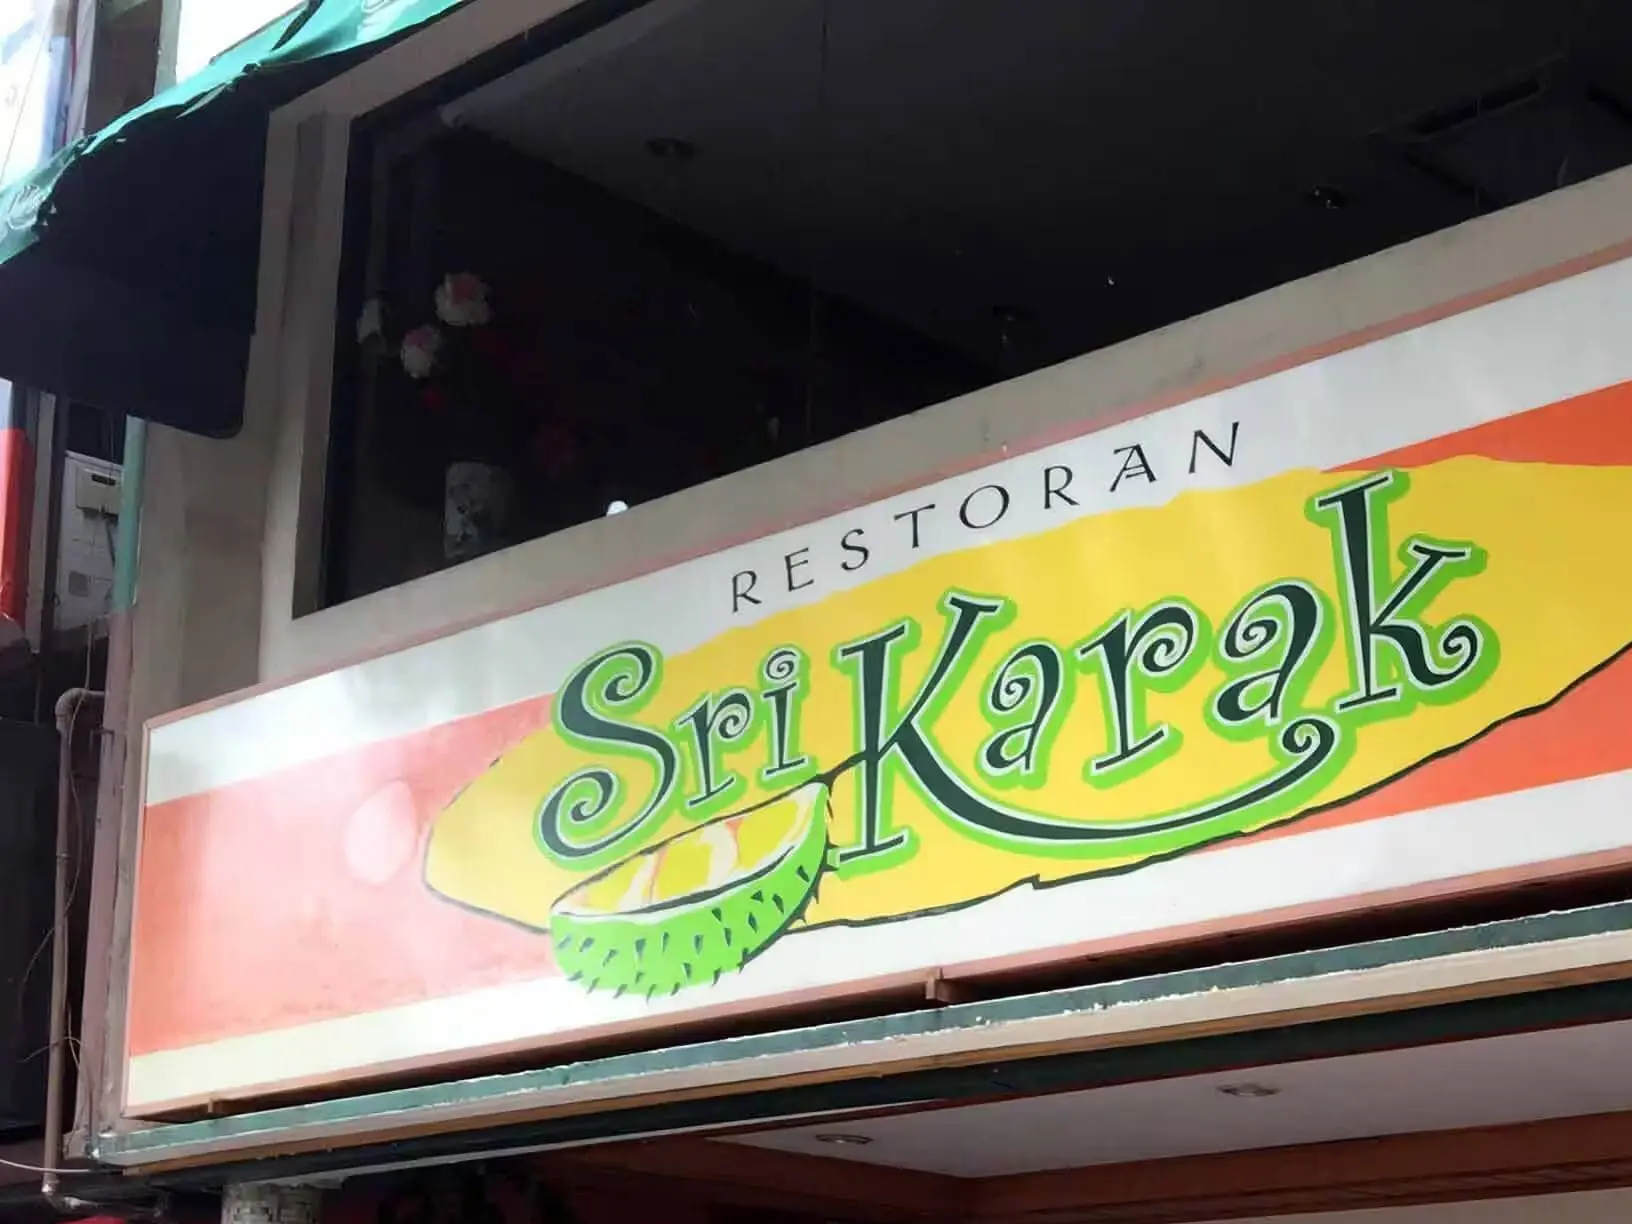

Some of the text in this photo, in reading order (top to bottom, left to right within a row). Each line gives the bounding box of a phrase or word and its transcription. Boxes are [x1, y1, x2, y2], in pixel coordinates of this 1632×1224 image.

[731, 422, 1240, 613] RESTORAN
[538, 472, 1479, 866] Sri Karak
